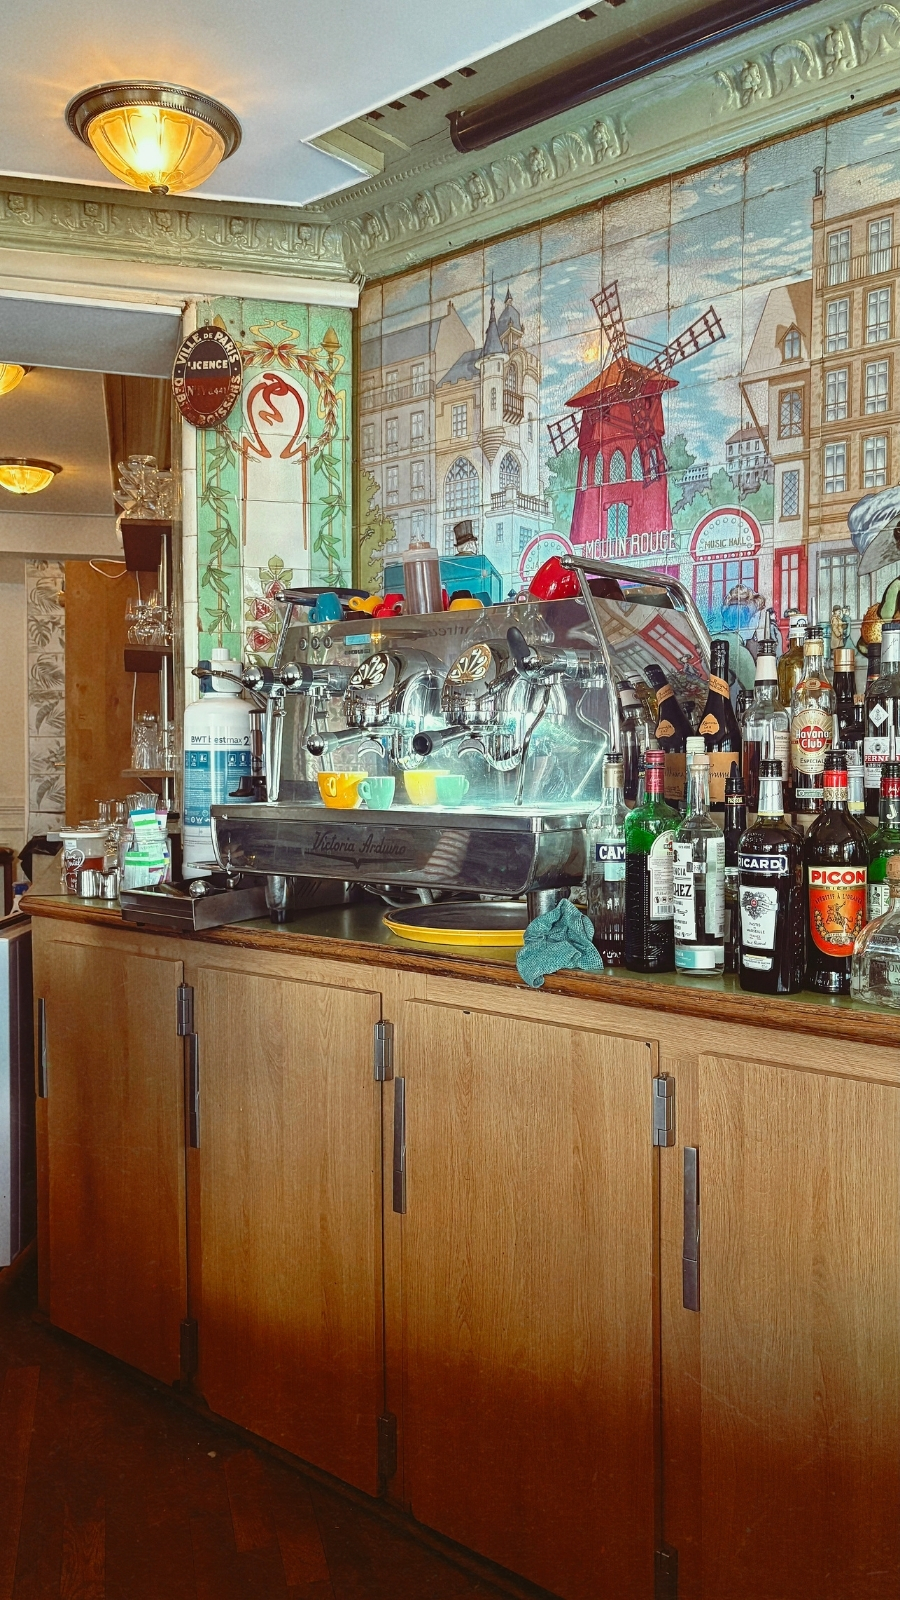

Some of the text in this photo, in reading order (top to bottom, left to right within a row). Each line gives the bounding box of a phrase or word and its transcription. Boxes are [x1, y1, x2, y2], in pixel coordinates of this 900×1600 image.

[176, 333, 202, 365] VILLE
[214, 332, 239, 364] PARIS
[585, 529, 677, 560] MOULIN ROUGE
[704, 537, 746, 549] MUSIC HALL
[190, 735, 207, 743] BWT
[796, 729, 829, 739] Havana
[801, 739, 822, 748] Club
[312, 830, 406, 856] Victoria Arduino
[811, 870, 866, 885] PICON
[673, 883, 692, 897] HEZ
